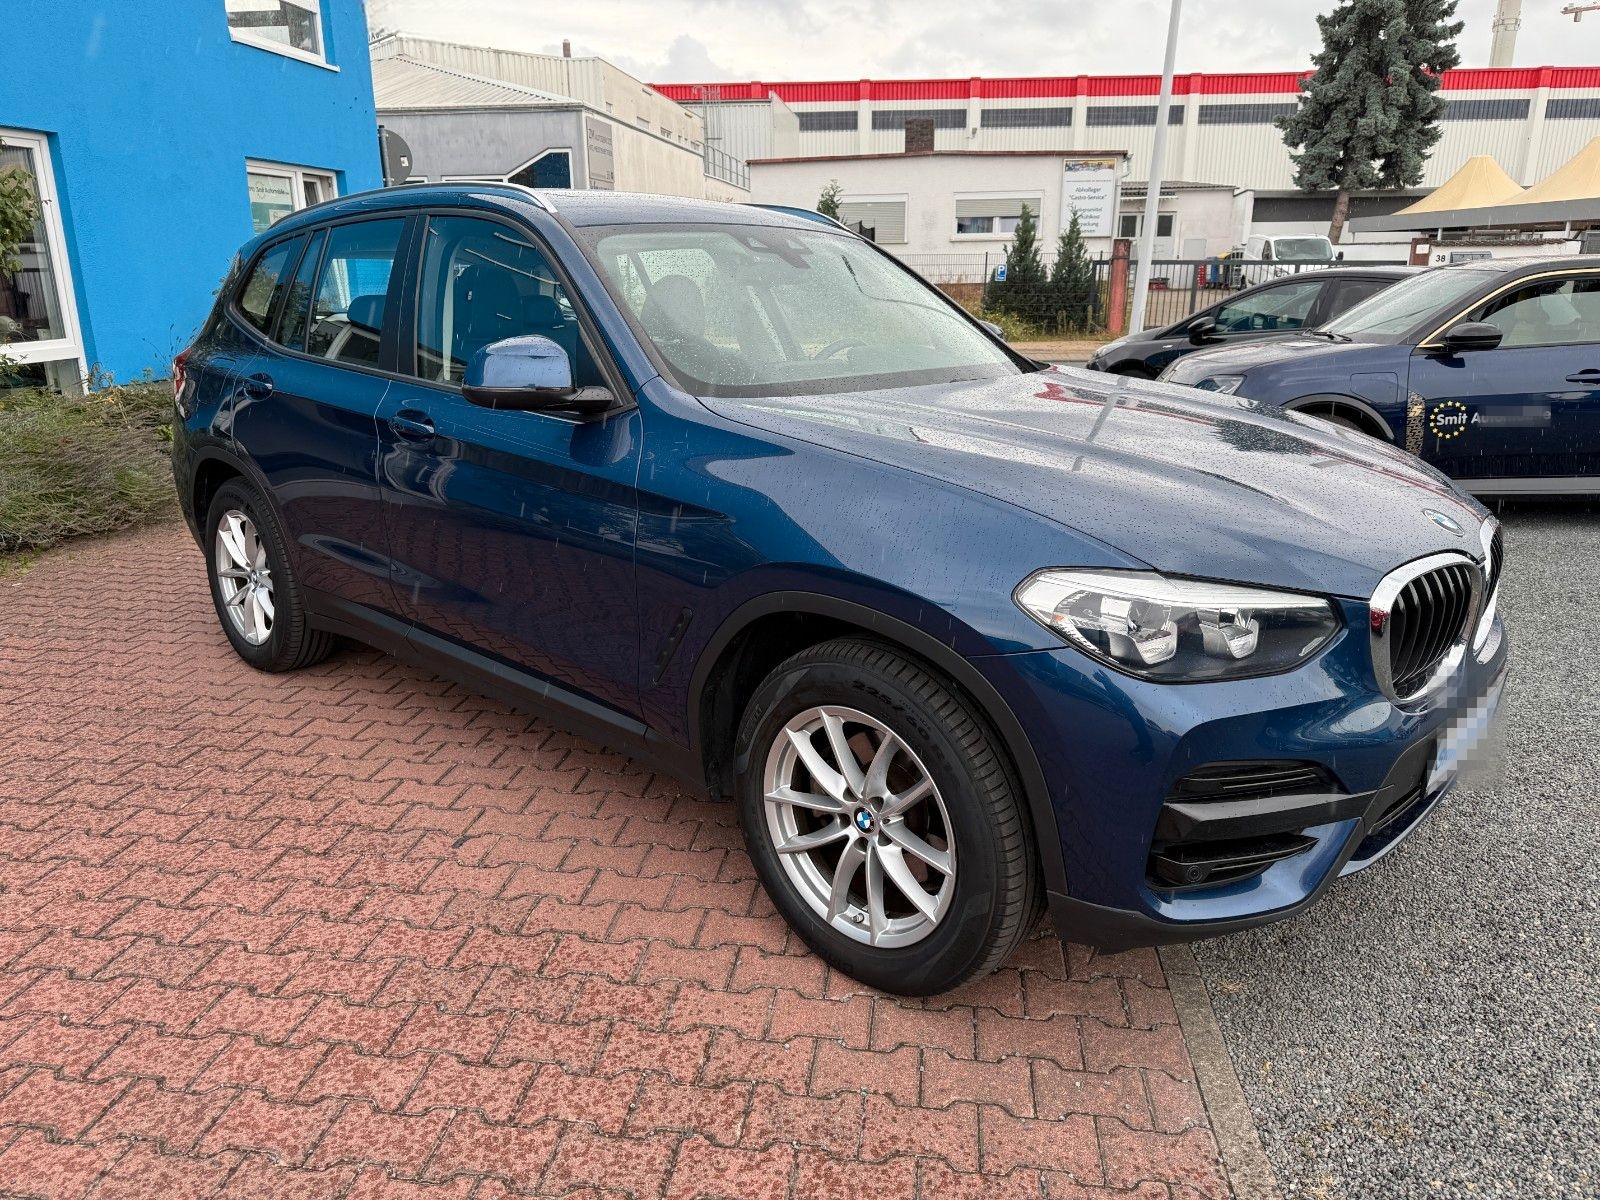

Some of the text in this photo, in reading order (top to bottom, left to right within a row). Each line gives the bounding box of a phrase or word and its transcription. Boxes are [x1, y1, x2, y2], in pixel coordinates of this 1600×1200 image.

[1435, 254, 1446, 263] 38
[998, 266, 1005, 274] P
[1436, 411, 1551, 426] Smit Automoe
